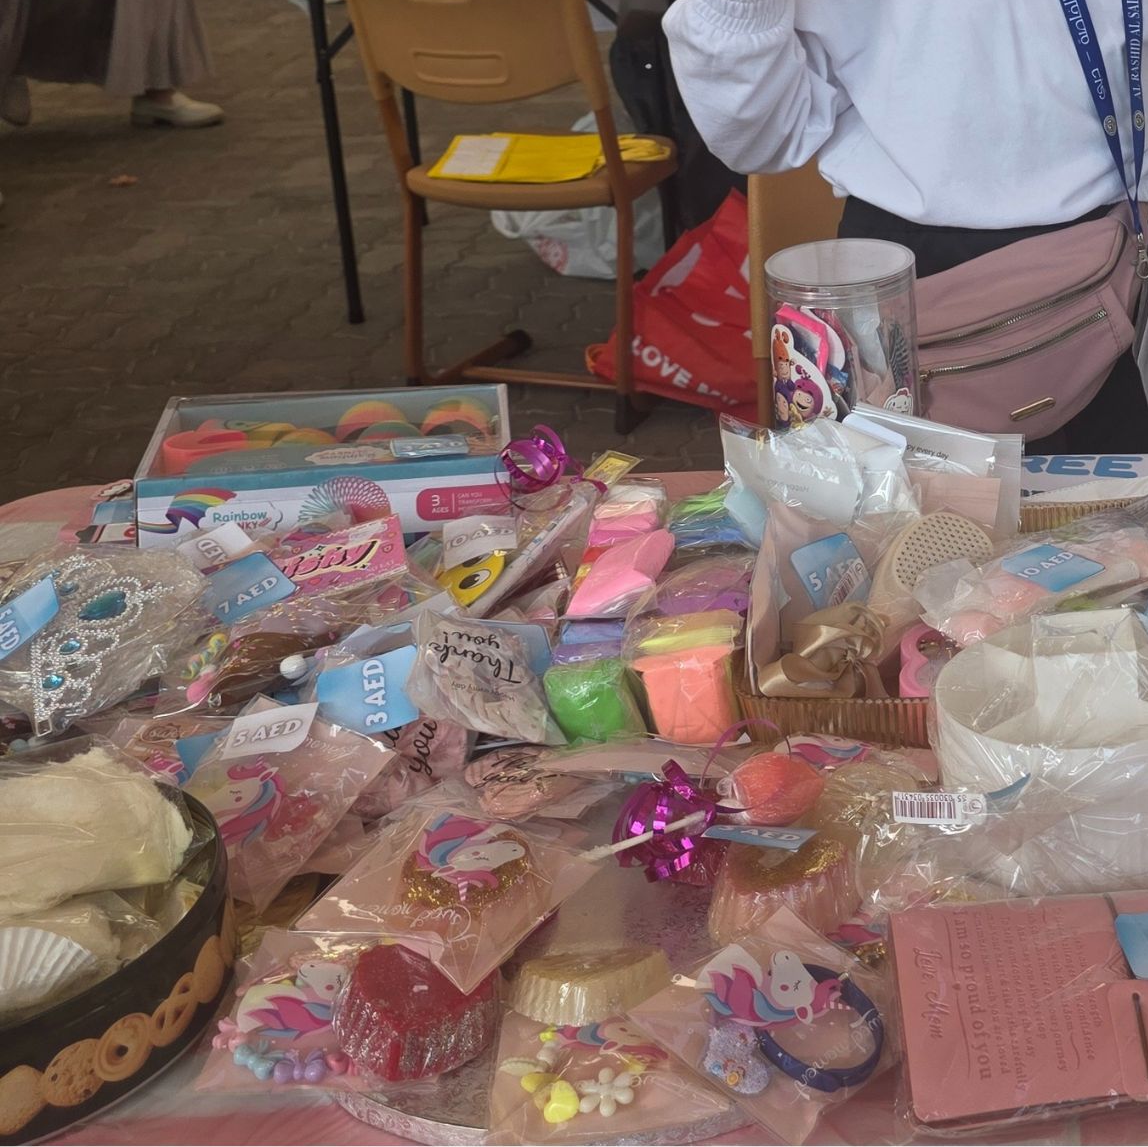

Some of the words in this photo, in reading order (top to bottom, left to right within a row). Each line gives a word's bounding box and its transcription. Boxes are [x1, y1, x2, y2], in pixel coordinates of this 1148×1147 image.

[1128, 19, 1142, 35] AL
[1130, 38, 1142, 82] RASHID
[1132, 83, 1142, 99] AL
[632, 335, 692, 388] LOVE
[915, 446, 935, 457] every
[935, 450, 948, 460] day
[213, 510, 267, 523] Rainbow
[1040, 551, 1074, 571] AED
[806, 571, 824, 591] 5
[218, 600, 230, 614] 7
[236, 576, 279, 605] AED
[443, 631, 501, 649] you!
[429, 642, 521, 683] Thank
[362, 660, 387, 708] AED
[450, 680, 467, 691] day
[366, 711, 388, 727] 3
[232, 729, 247, 747] 5
[250, 719, 302, 742] AED
[741, 827, 801, 842] AED
[955, 920, 970, 940] am
[959, 942, 971, 959] so
[959, 964, 987, 1015] proud
[921, 991, 950, 1041] Mom
[972, 1019, 991, 1042] of
[971, 1042, 992, 1081] you
